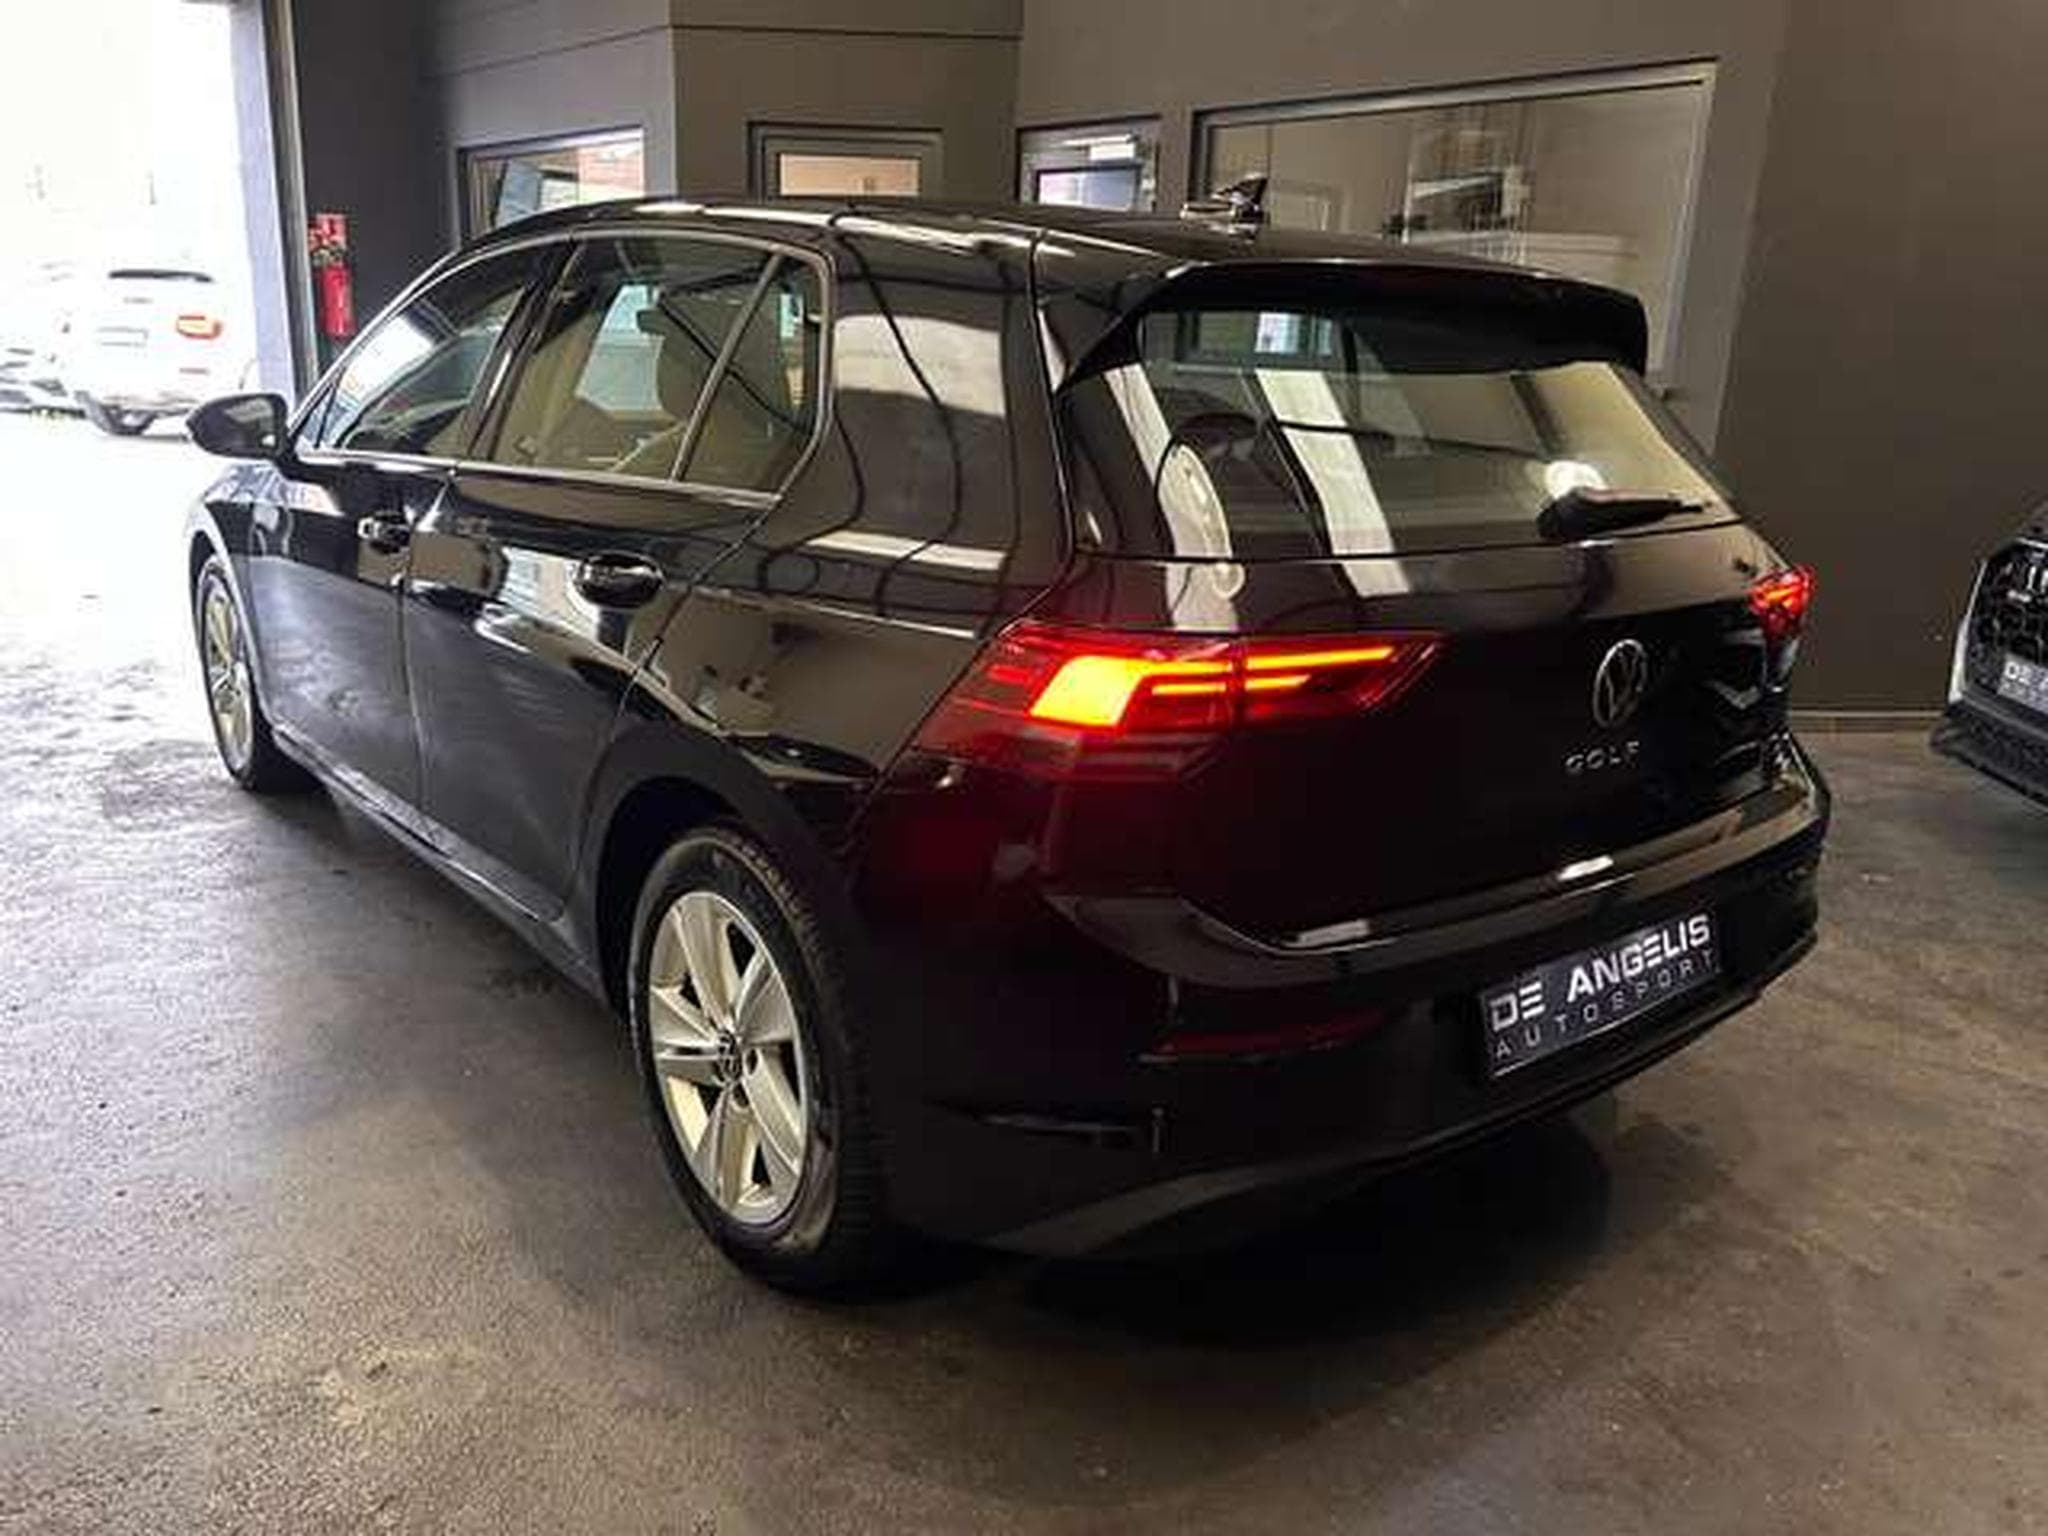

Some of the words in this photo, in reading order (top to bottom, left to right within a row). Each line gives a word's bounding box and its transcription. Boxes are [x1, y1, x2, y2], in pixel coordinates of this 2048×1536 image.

[1490, 981, 1546, 1032] DE
[1566, 913, 1711, 1003] ANGELIS
[1496, 949, 1713, 1059] AUTOSPORT
